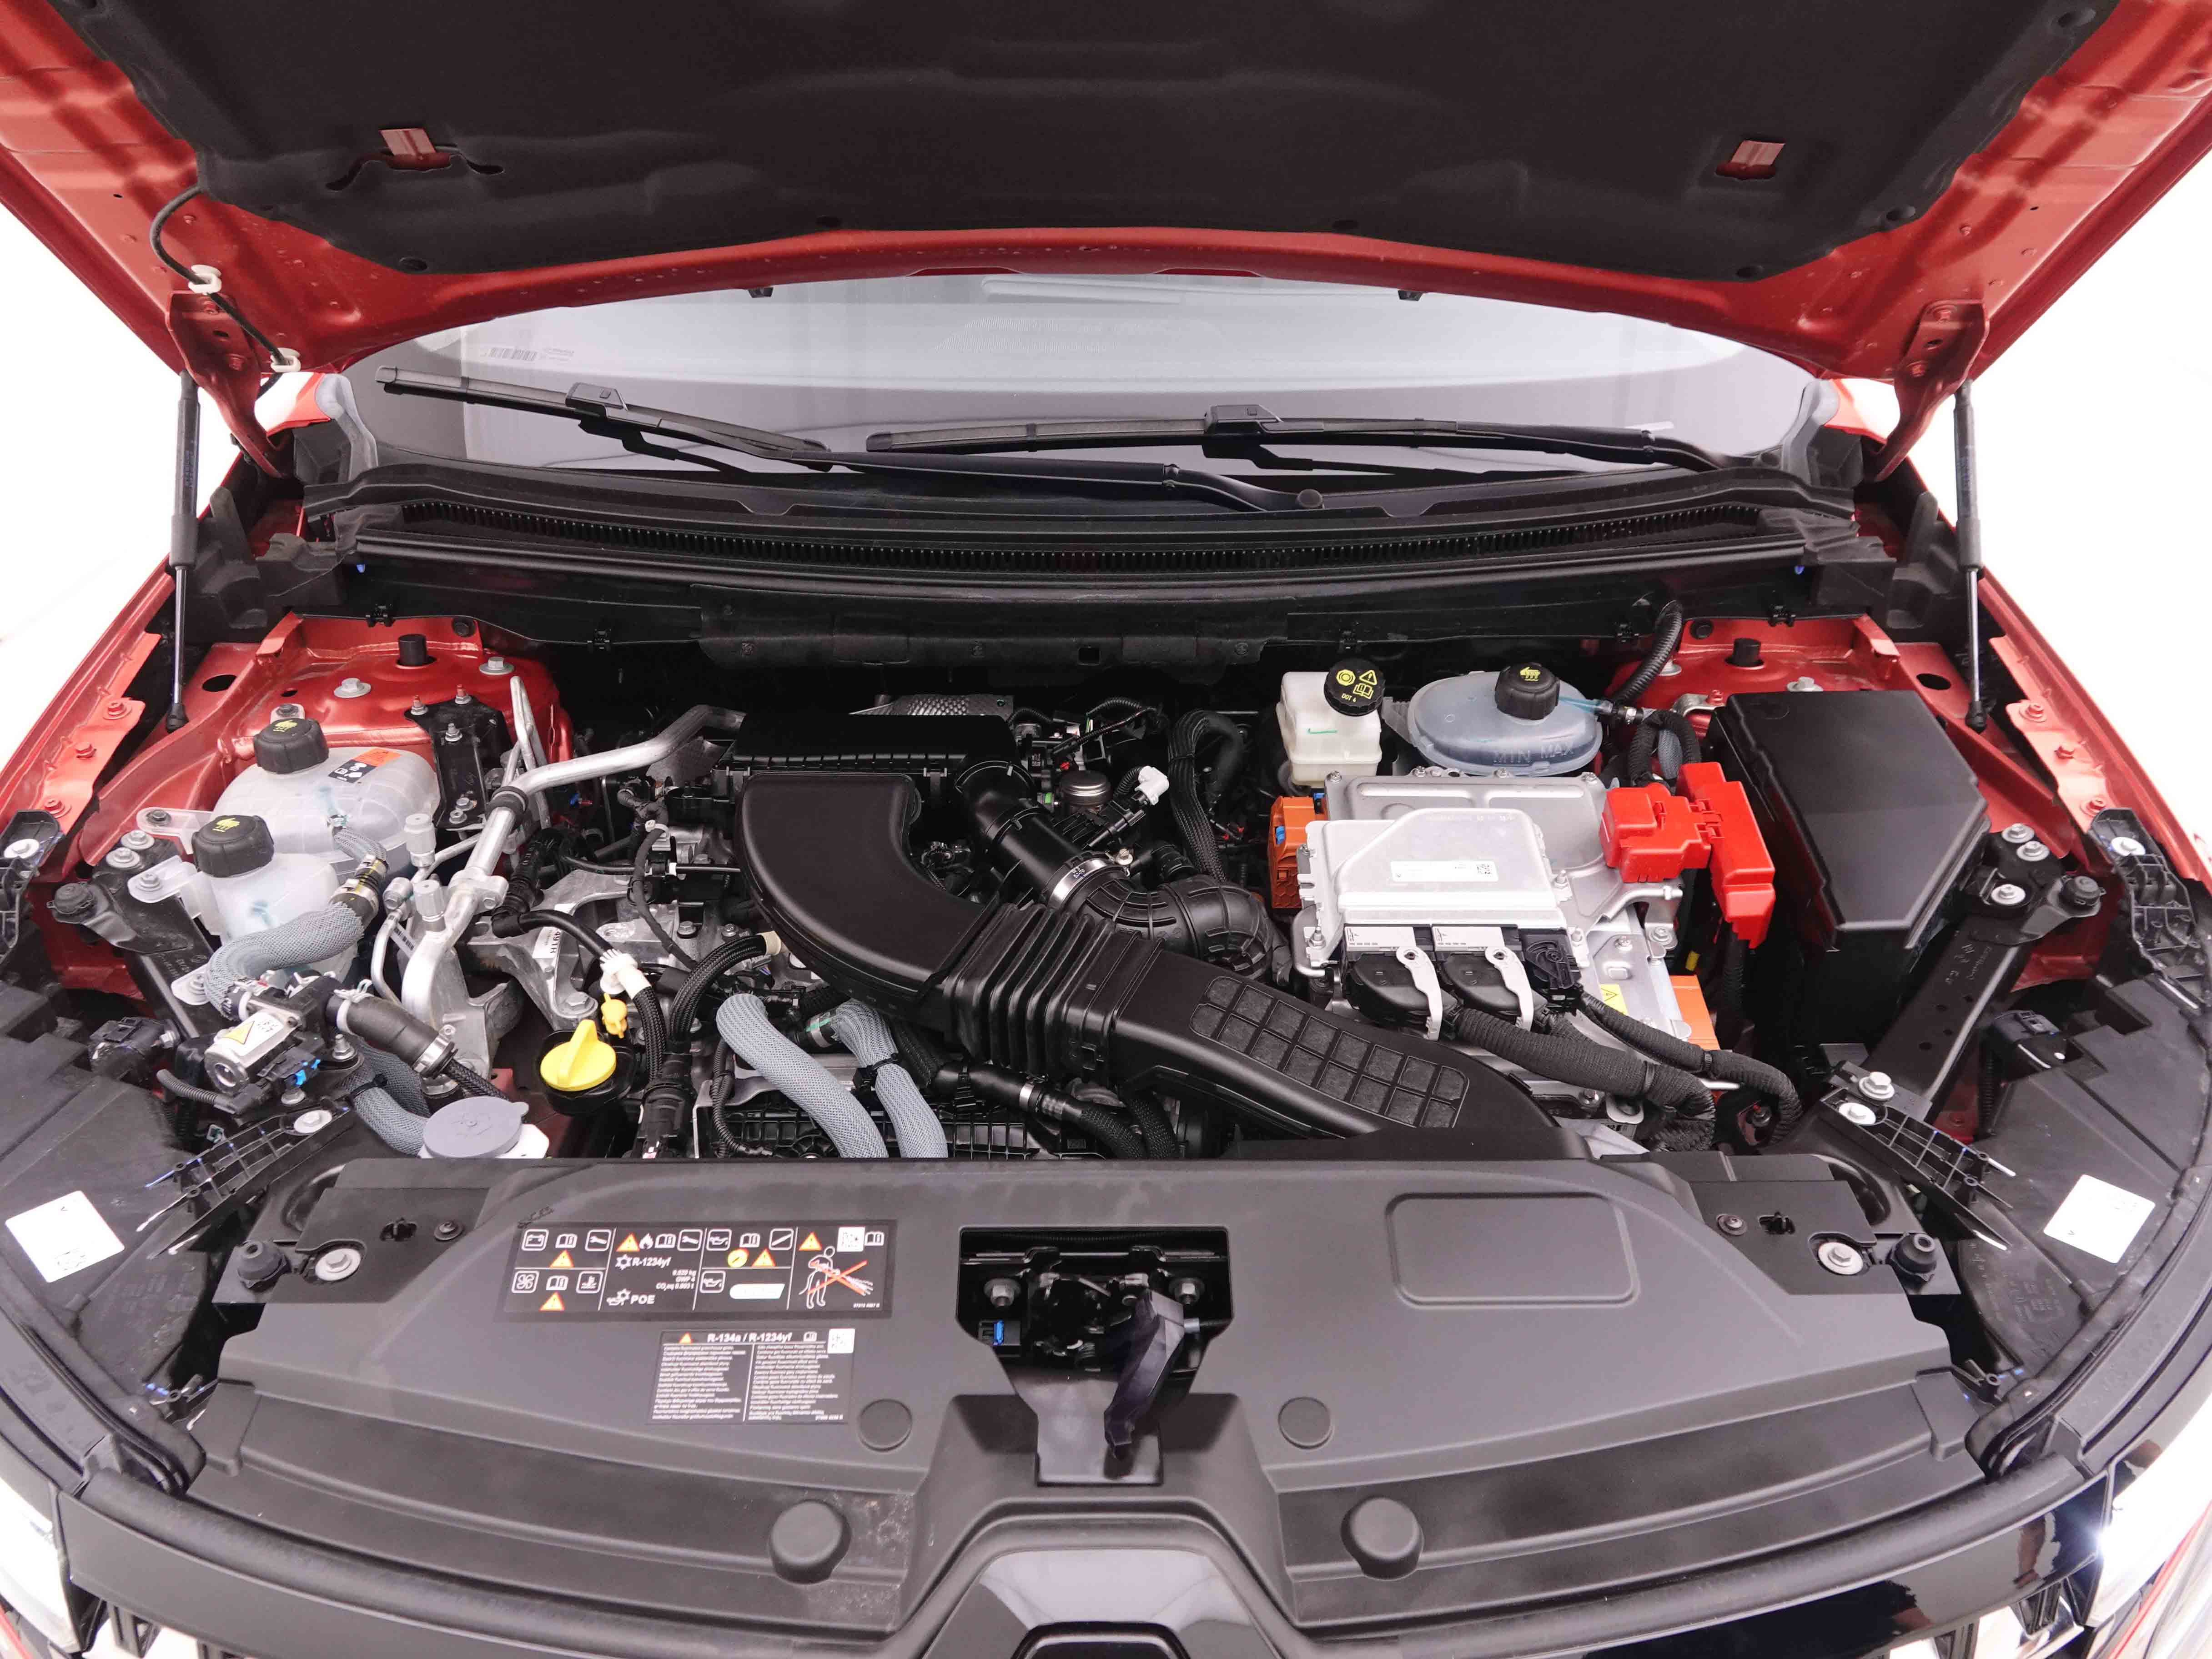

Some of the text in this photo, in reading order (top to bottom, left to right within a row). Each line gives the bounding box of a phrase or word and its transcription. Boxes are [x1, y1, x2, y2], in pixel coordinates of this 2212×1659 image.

[1540, 742, 1575, 759] MAX
[1493, 750, 1531, 763] MIN
[632, 1257, 672, 1268] R-1234yf
[630, 1294, 655, 1304] POE
[707, 1333, 741, 1342] R-134a
[749, 1332, 793, 1343] R-1234yf
